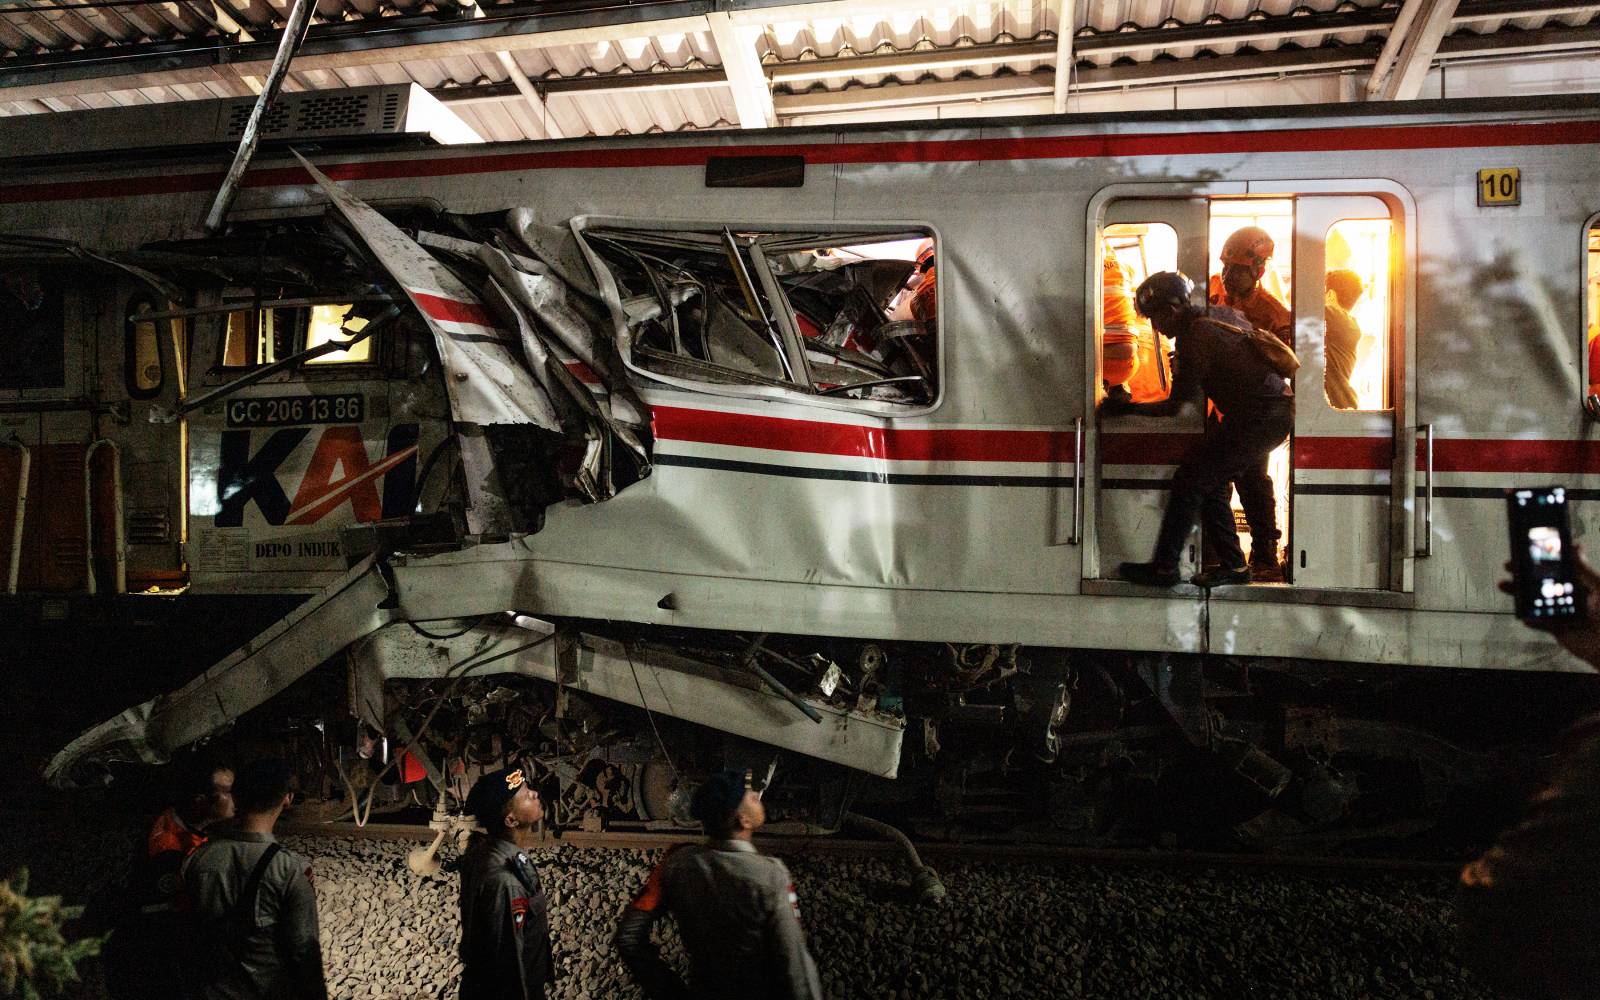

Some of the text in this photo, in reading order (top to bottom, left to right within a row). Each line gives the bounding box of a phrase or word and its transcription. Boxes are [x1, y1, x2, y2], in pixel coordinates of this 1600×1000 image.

[1485, 173, 1513, 197] 10
[231, 397, 359, 422] CC 206 13 86
[215, 424, 420, 527] KAI
[255, 541, 341, 558] DEPO INDUK
